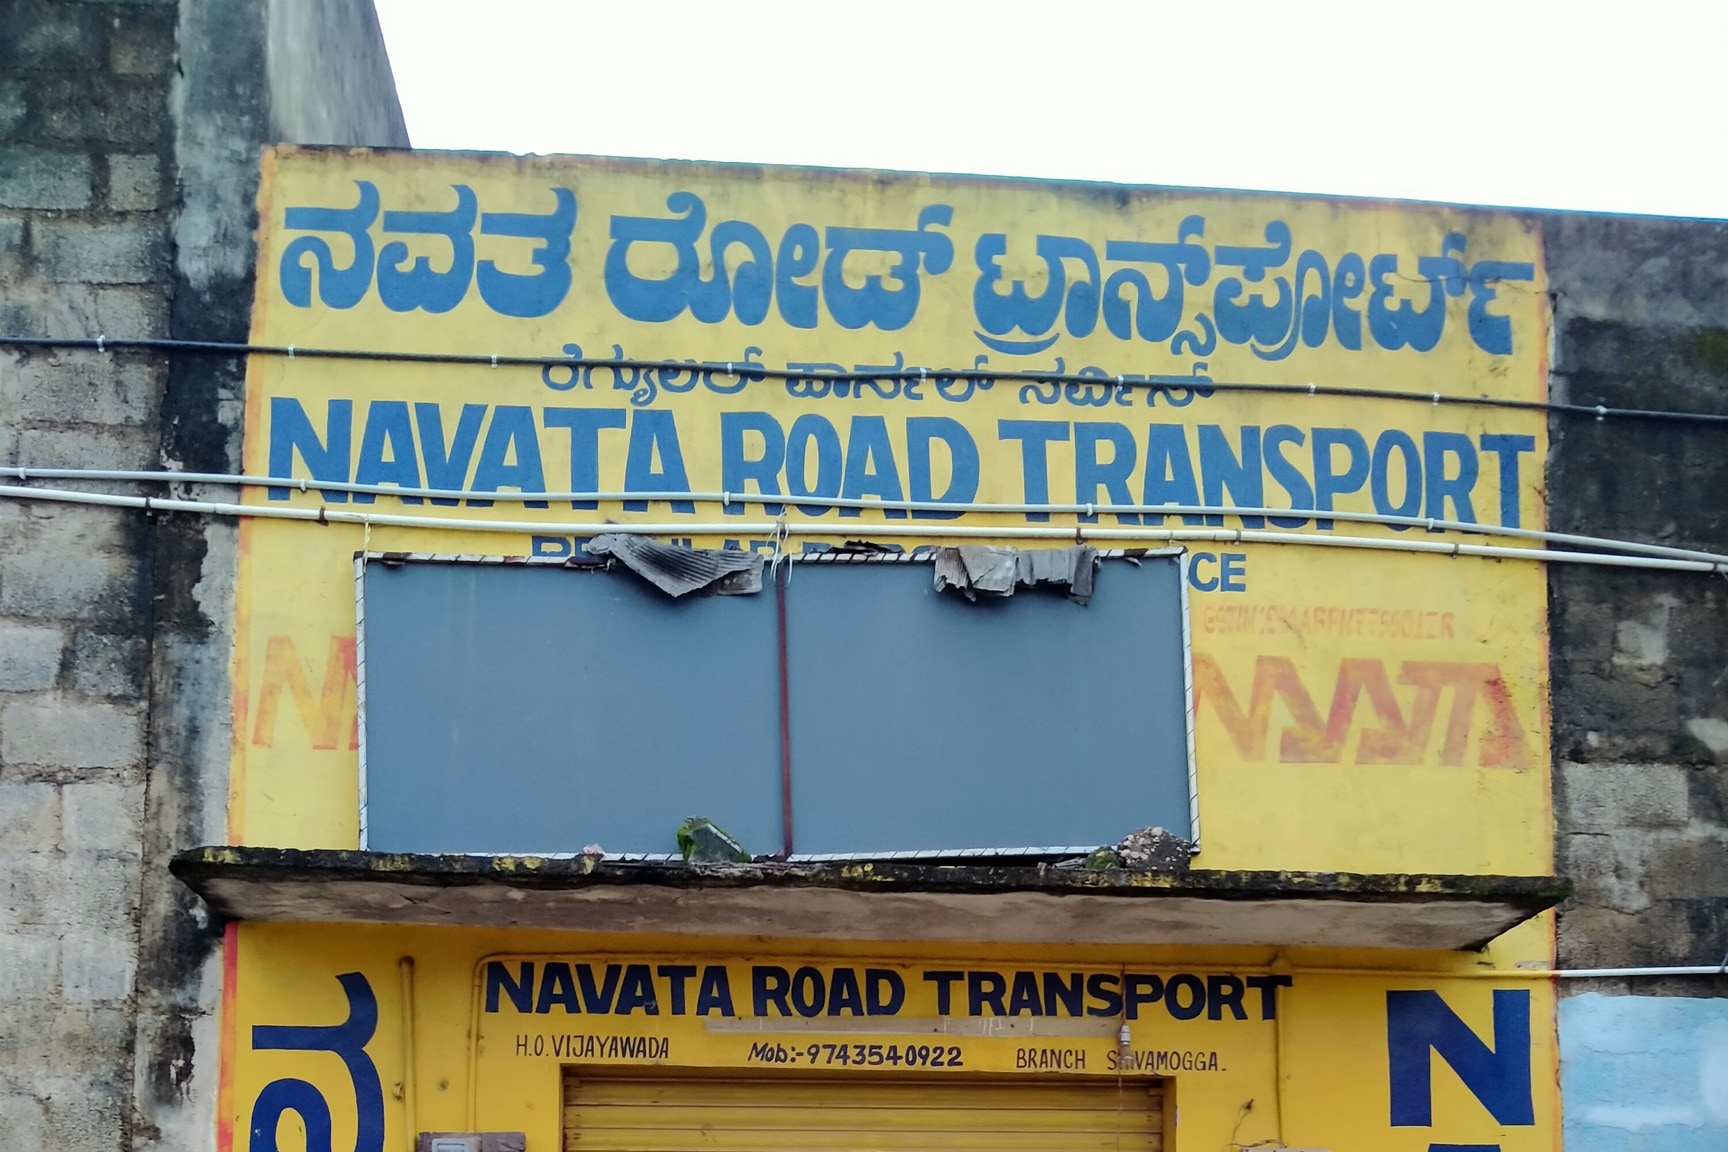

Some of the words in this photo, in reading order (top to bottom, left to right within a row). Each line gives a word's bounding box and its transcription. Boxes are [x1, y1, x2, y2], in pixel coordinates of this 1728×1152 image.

[279, 180, 577, 318] ನವತ
[604, 191, 953, 331] ರೋಡ್
[268, 397, 695, 514] NAVATA
[721, 411, 980, 519] ROAD
[998, 419, 1535, 531] TRANSPORT
[485, 960, 735, 1017] NAVATA
[751, 966, 905, 1018] ROAD
[923, 971, 1293, 1021] TRANSPORT
[1016, 1048, 1086, 1070] BRANCH
[1106, 1050, 1227, 1071] SVAMOGGA.
